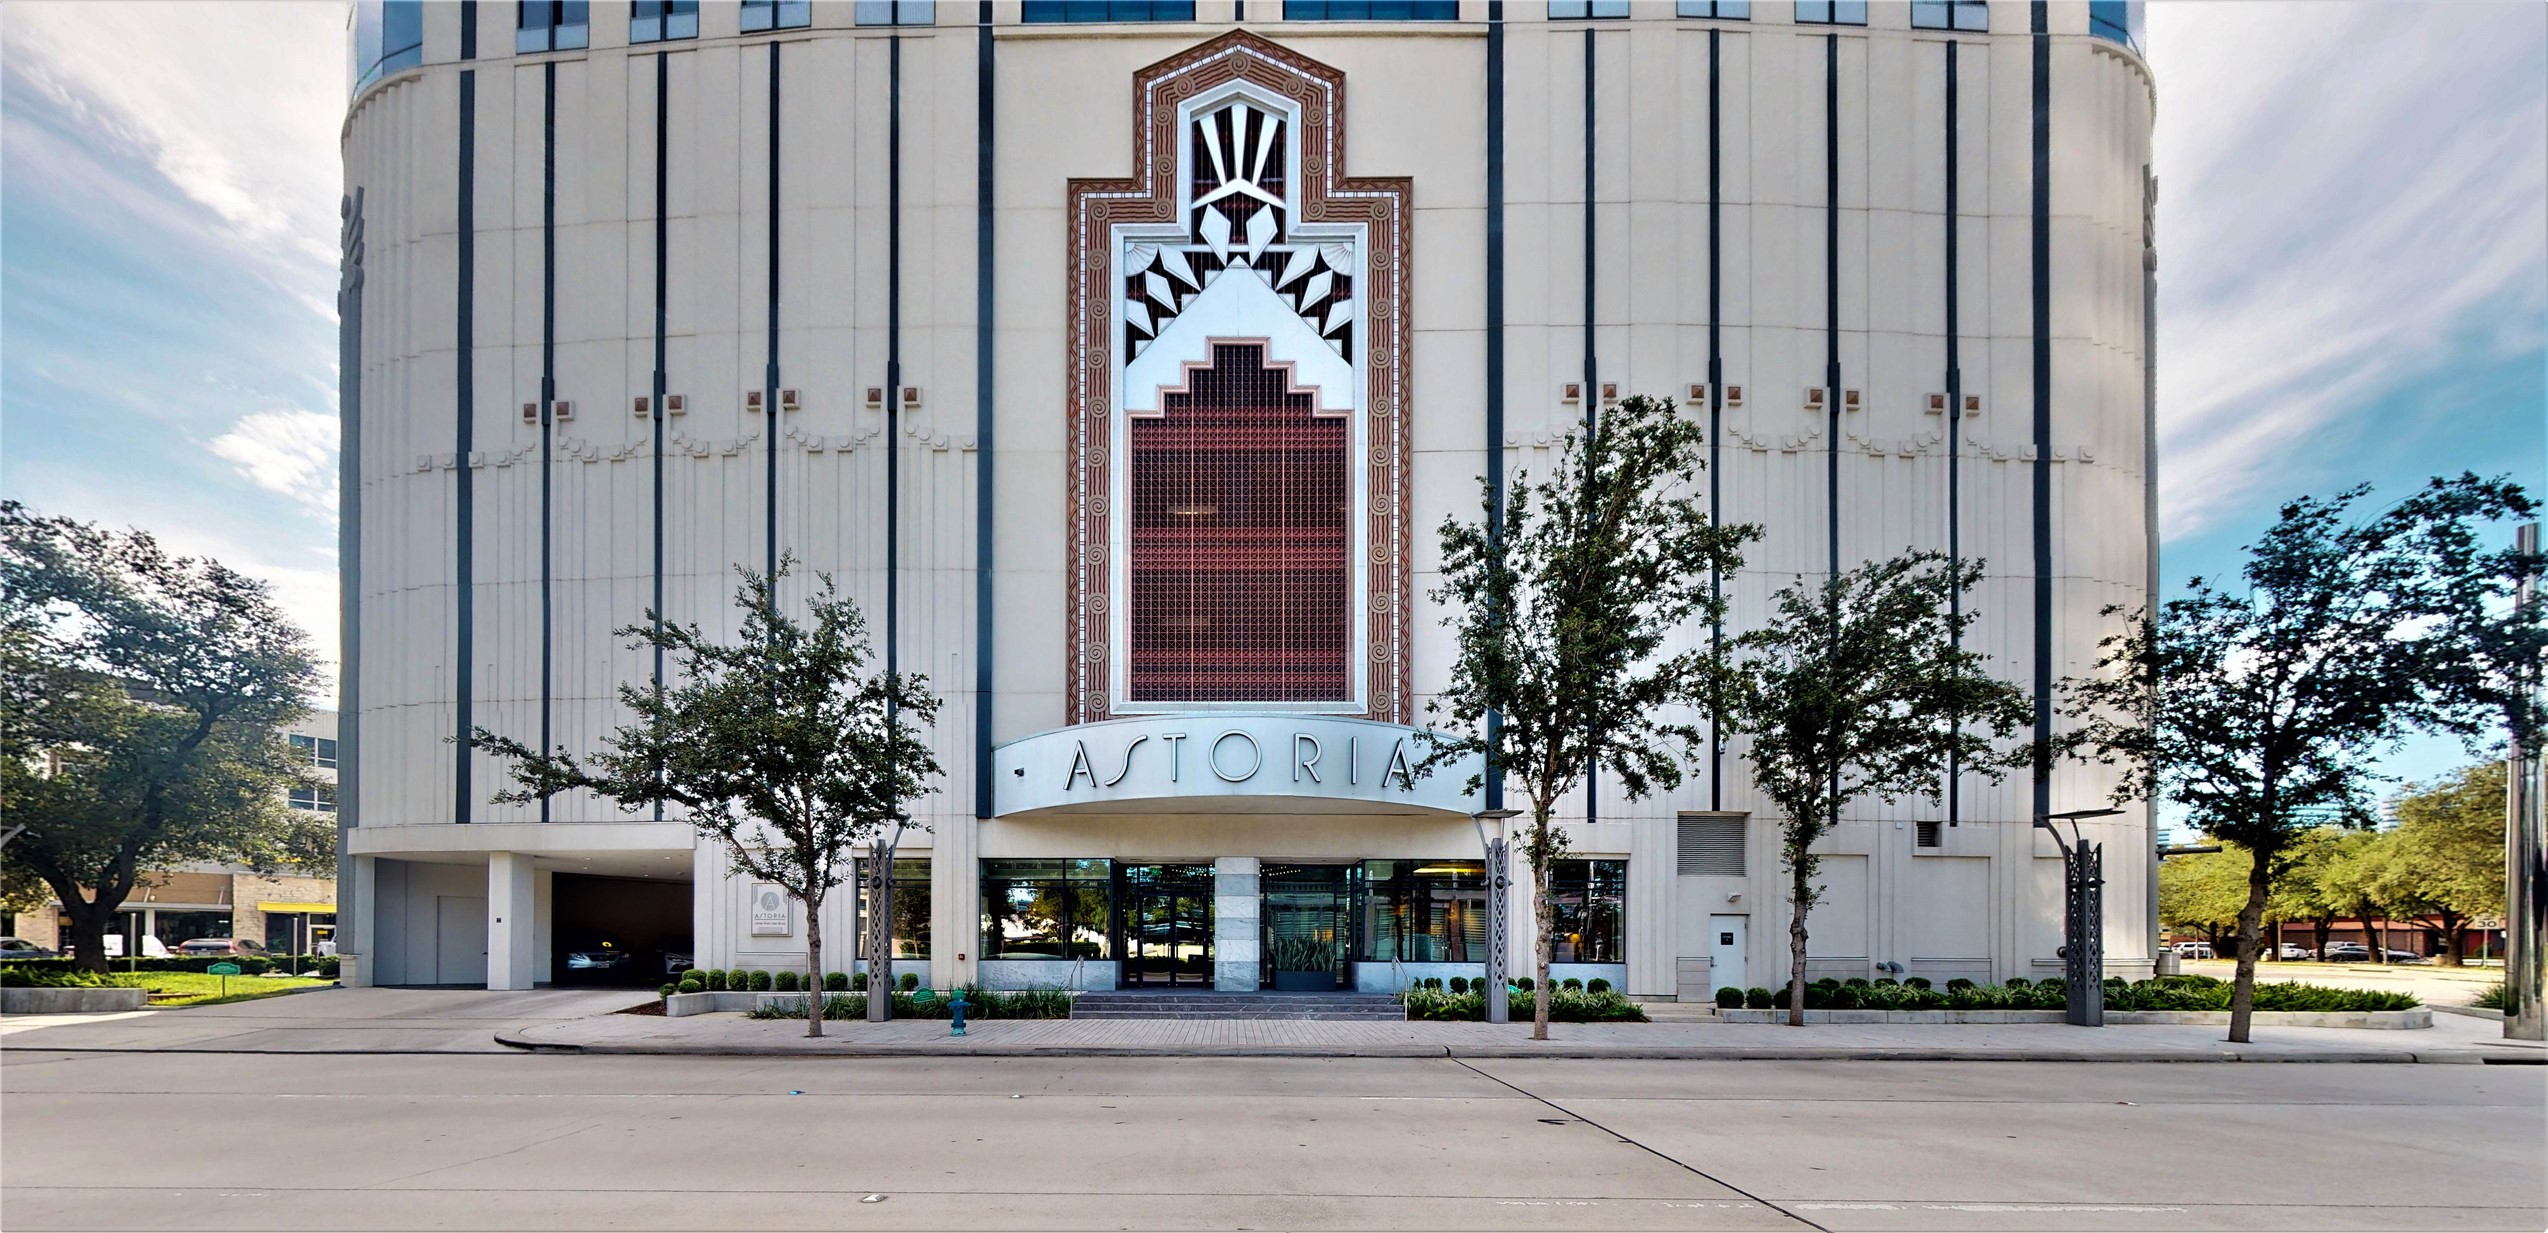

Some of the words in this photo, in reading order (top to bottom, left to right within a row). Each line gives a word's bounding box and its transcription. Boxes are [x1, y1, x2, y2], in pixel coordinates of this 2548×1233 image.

[1062, 728, 1417, 792] ASTORIA
[764, 895, 776, 910] A
[2476, 920, 2497, 928] 30
